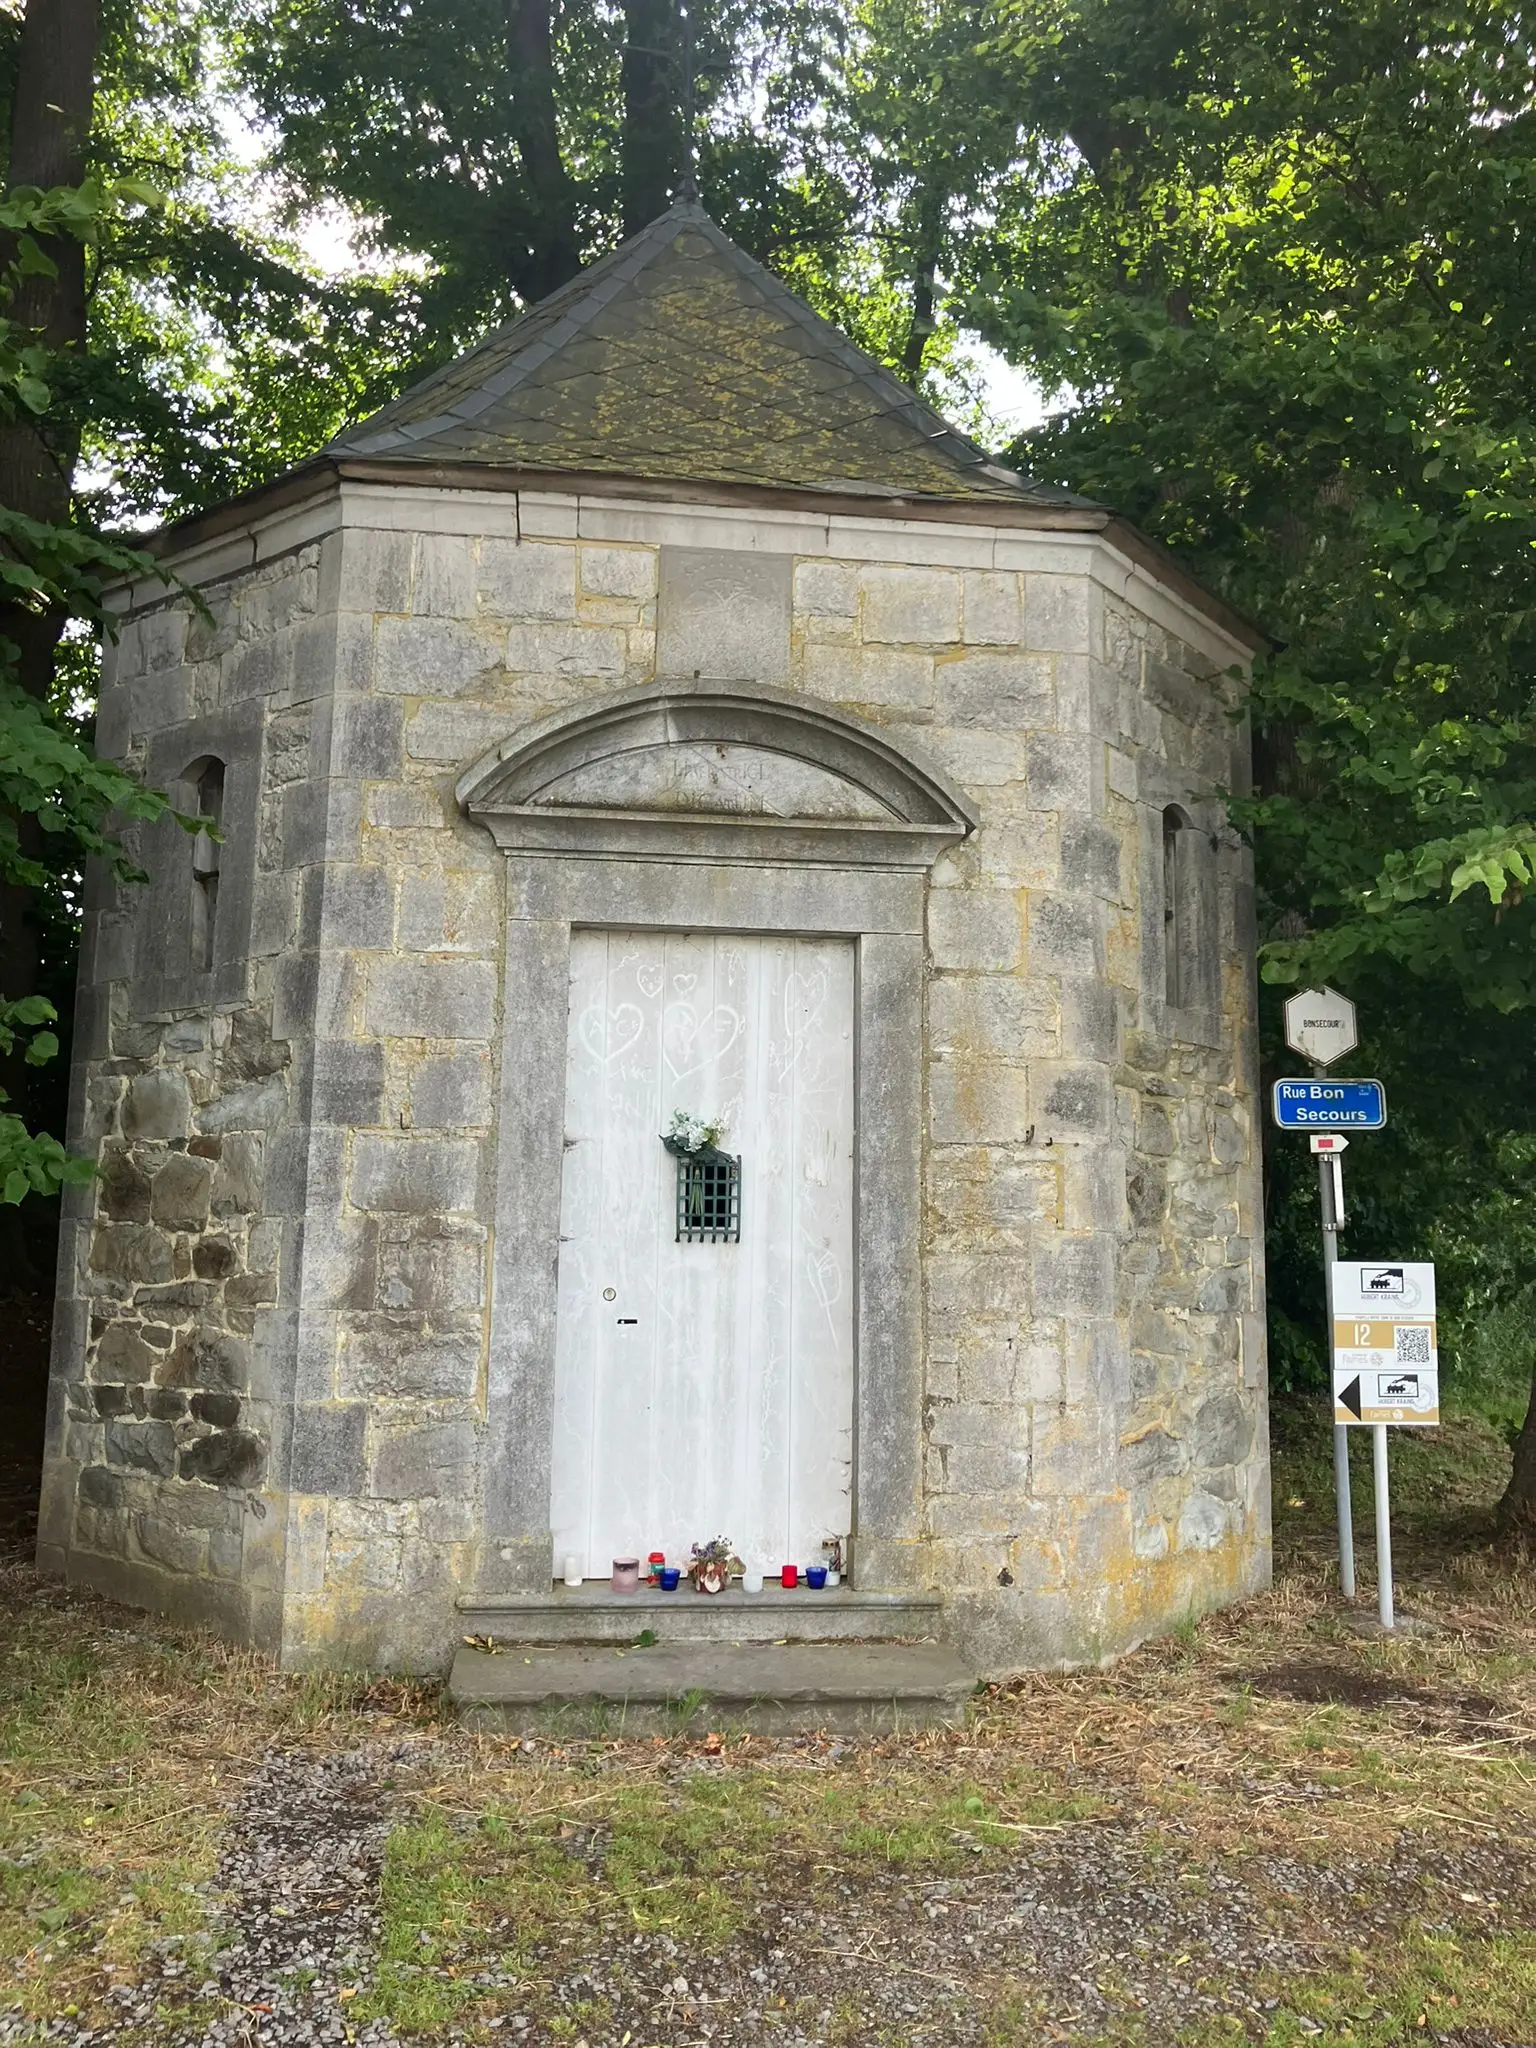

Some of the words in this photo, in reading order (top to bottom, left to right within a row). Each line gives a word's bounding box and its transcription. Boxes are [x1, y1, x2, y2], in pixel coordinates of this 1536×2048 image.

[1283, 1086, 1307, 1099] Rue
[1310, 1086, 1344, 1099] Bon
[1296, 1107, 1367, 1121] Secours
[1354, 1323, 1371, 1346] 12
